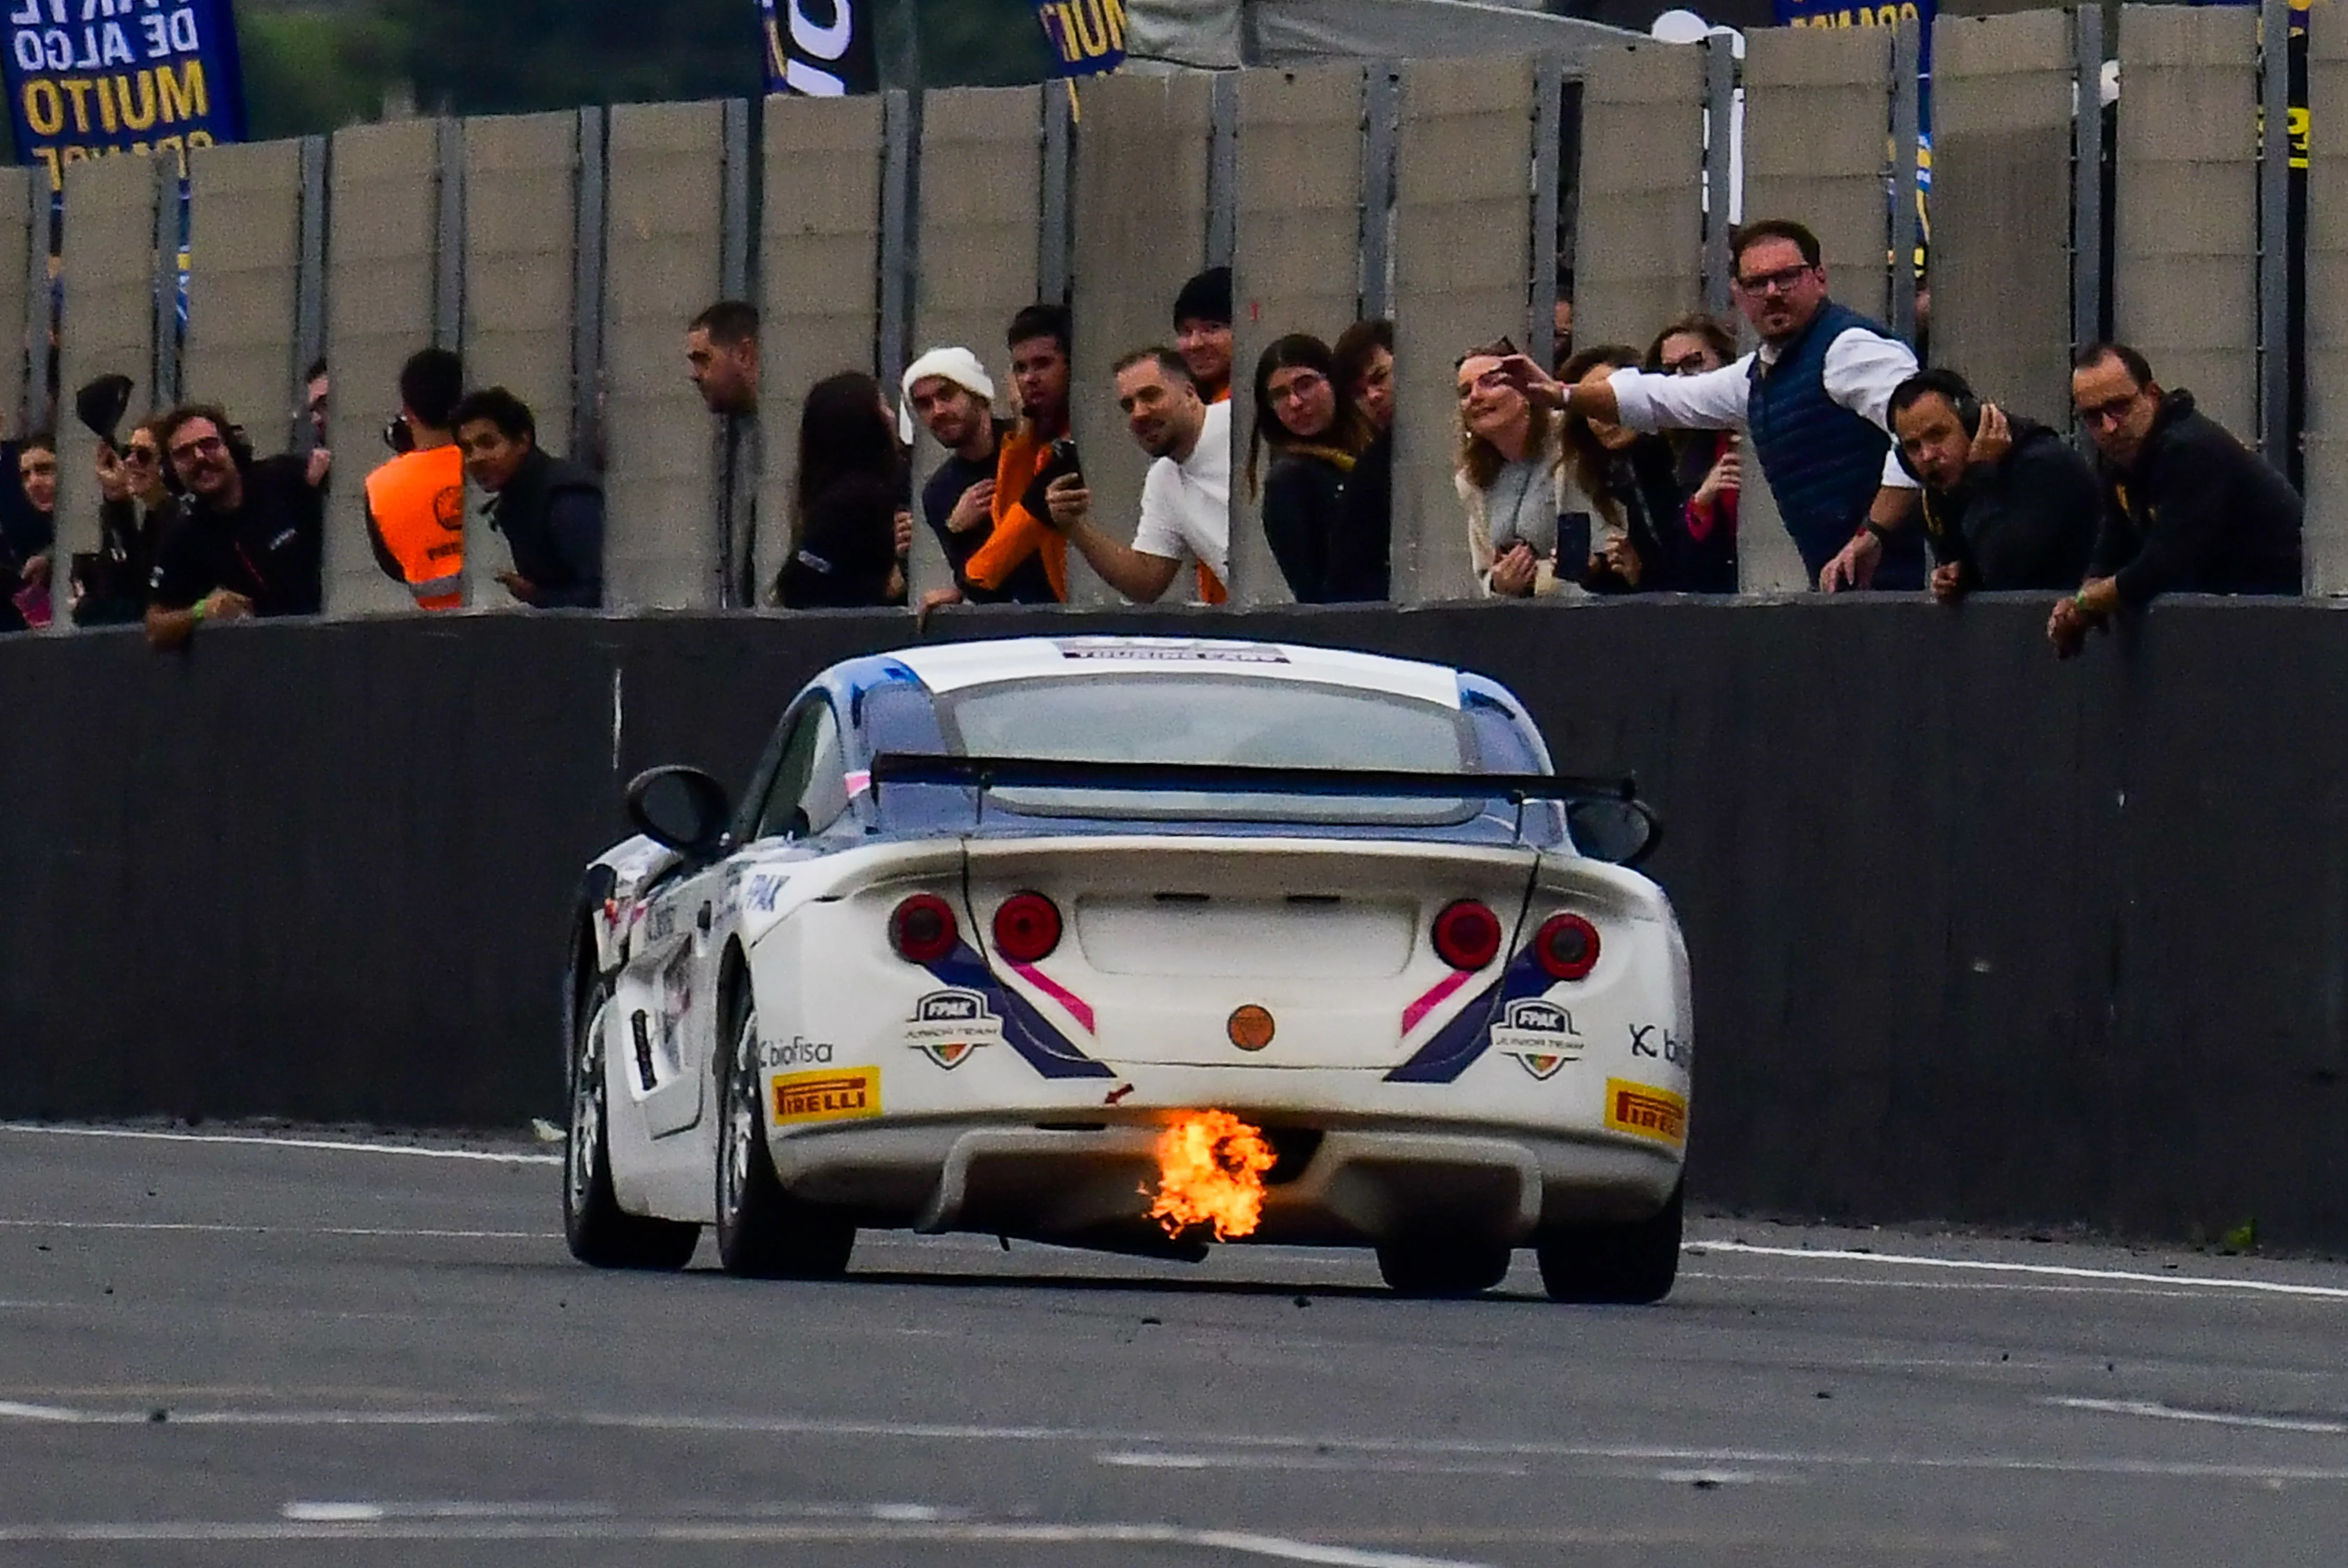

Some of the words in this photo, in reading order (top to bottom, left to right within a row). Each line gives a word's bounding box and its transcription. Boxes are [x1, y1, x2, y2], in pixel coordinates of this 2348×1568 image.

[927, 1001, 972, 1016] FPAK
[1518, 1011, 1560, 1028] FPAK
[776, 1076, 867, 1116] PIRELLI
